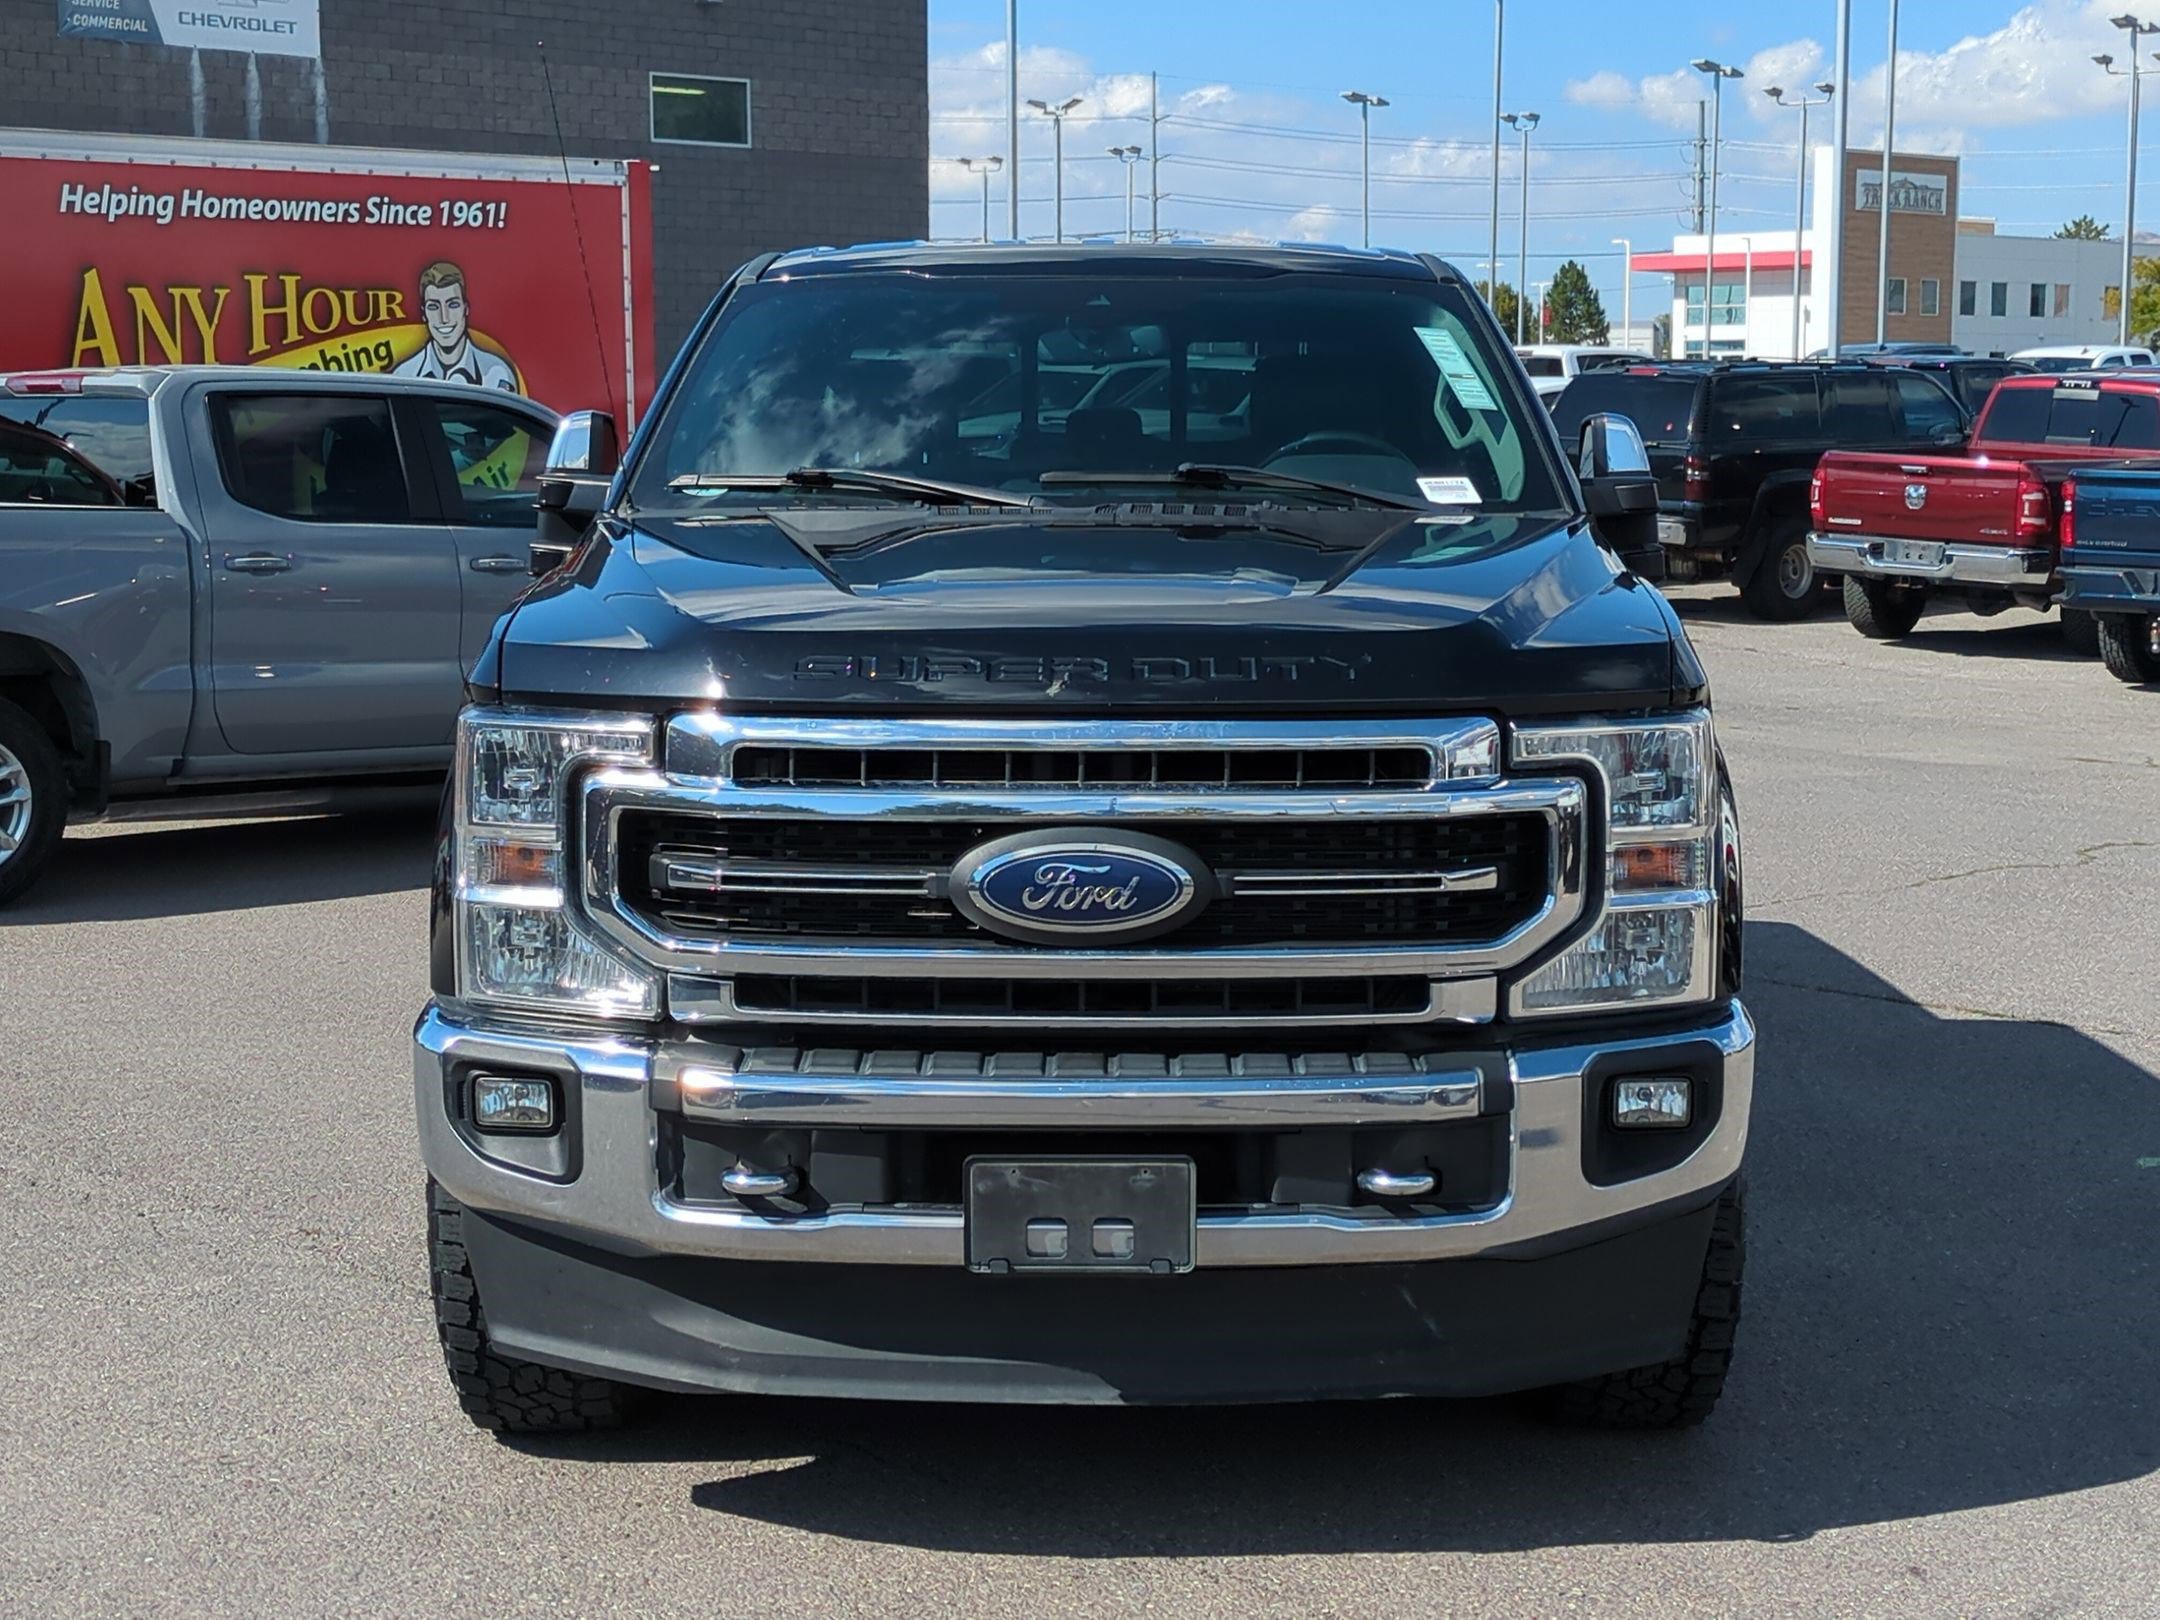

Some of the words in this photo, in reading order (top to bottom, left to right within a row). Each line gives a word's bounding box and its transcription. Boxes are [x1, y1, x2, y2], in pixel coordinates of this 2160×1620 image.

[73, 14, 148, 32] COMMERCIAL
[178, 11, 297, 34] CHEVROLET
[60, 184, 175, 224] Helping
[181, 189, 360, 223] Homeowners
[365, 196, 432, 226] Since
[440, 200, 507, 228] 1961!
[1862, 187, 1901, 209] TRCK
[72, 268, 231, 368] ANY
[244, 274, 406, 355] HOUR
[794, 656, 1108, 682] SUPER
[1131, 653, 1371, 682] DUTY
[1022, 863, 1140, 910] Ford
